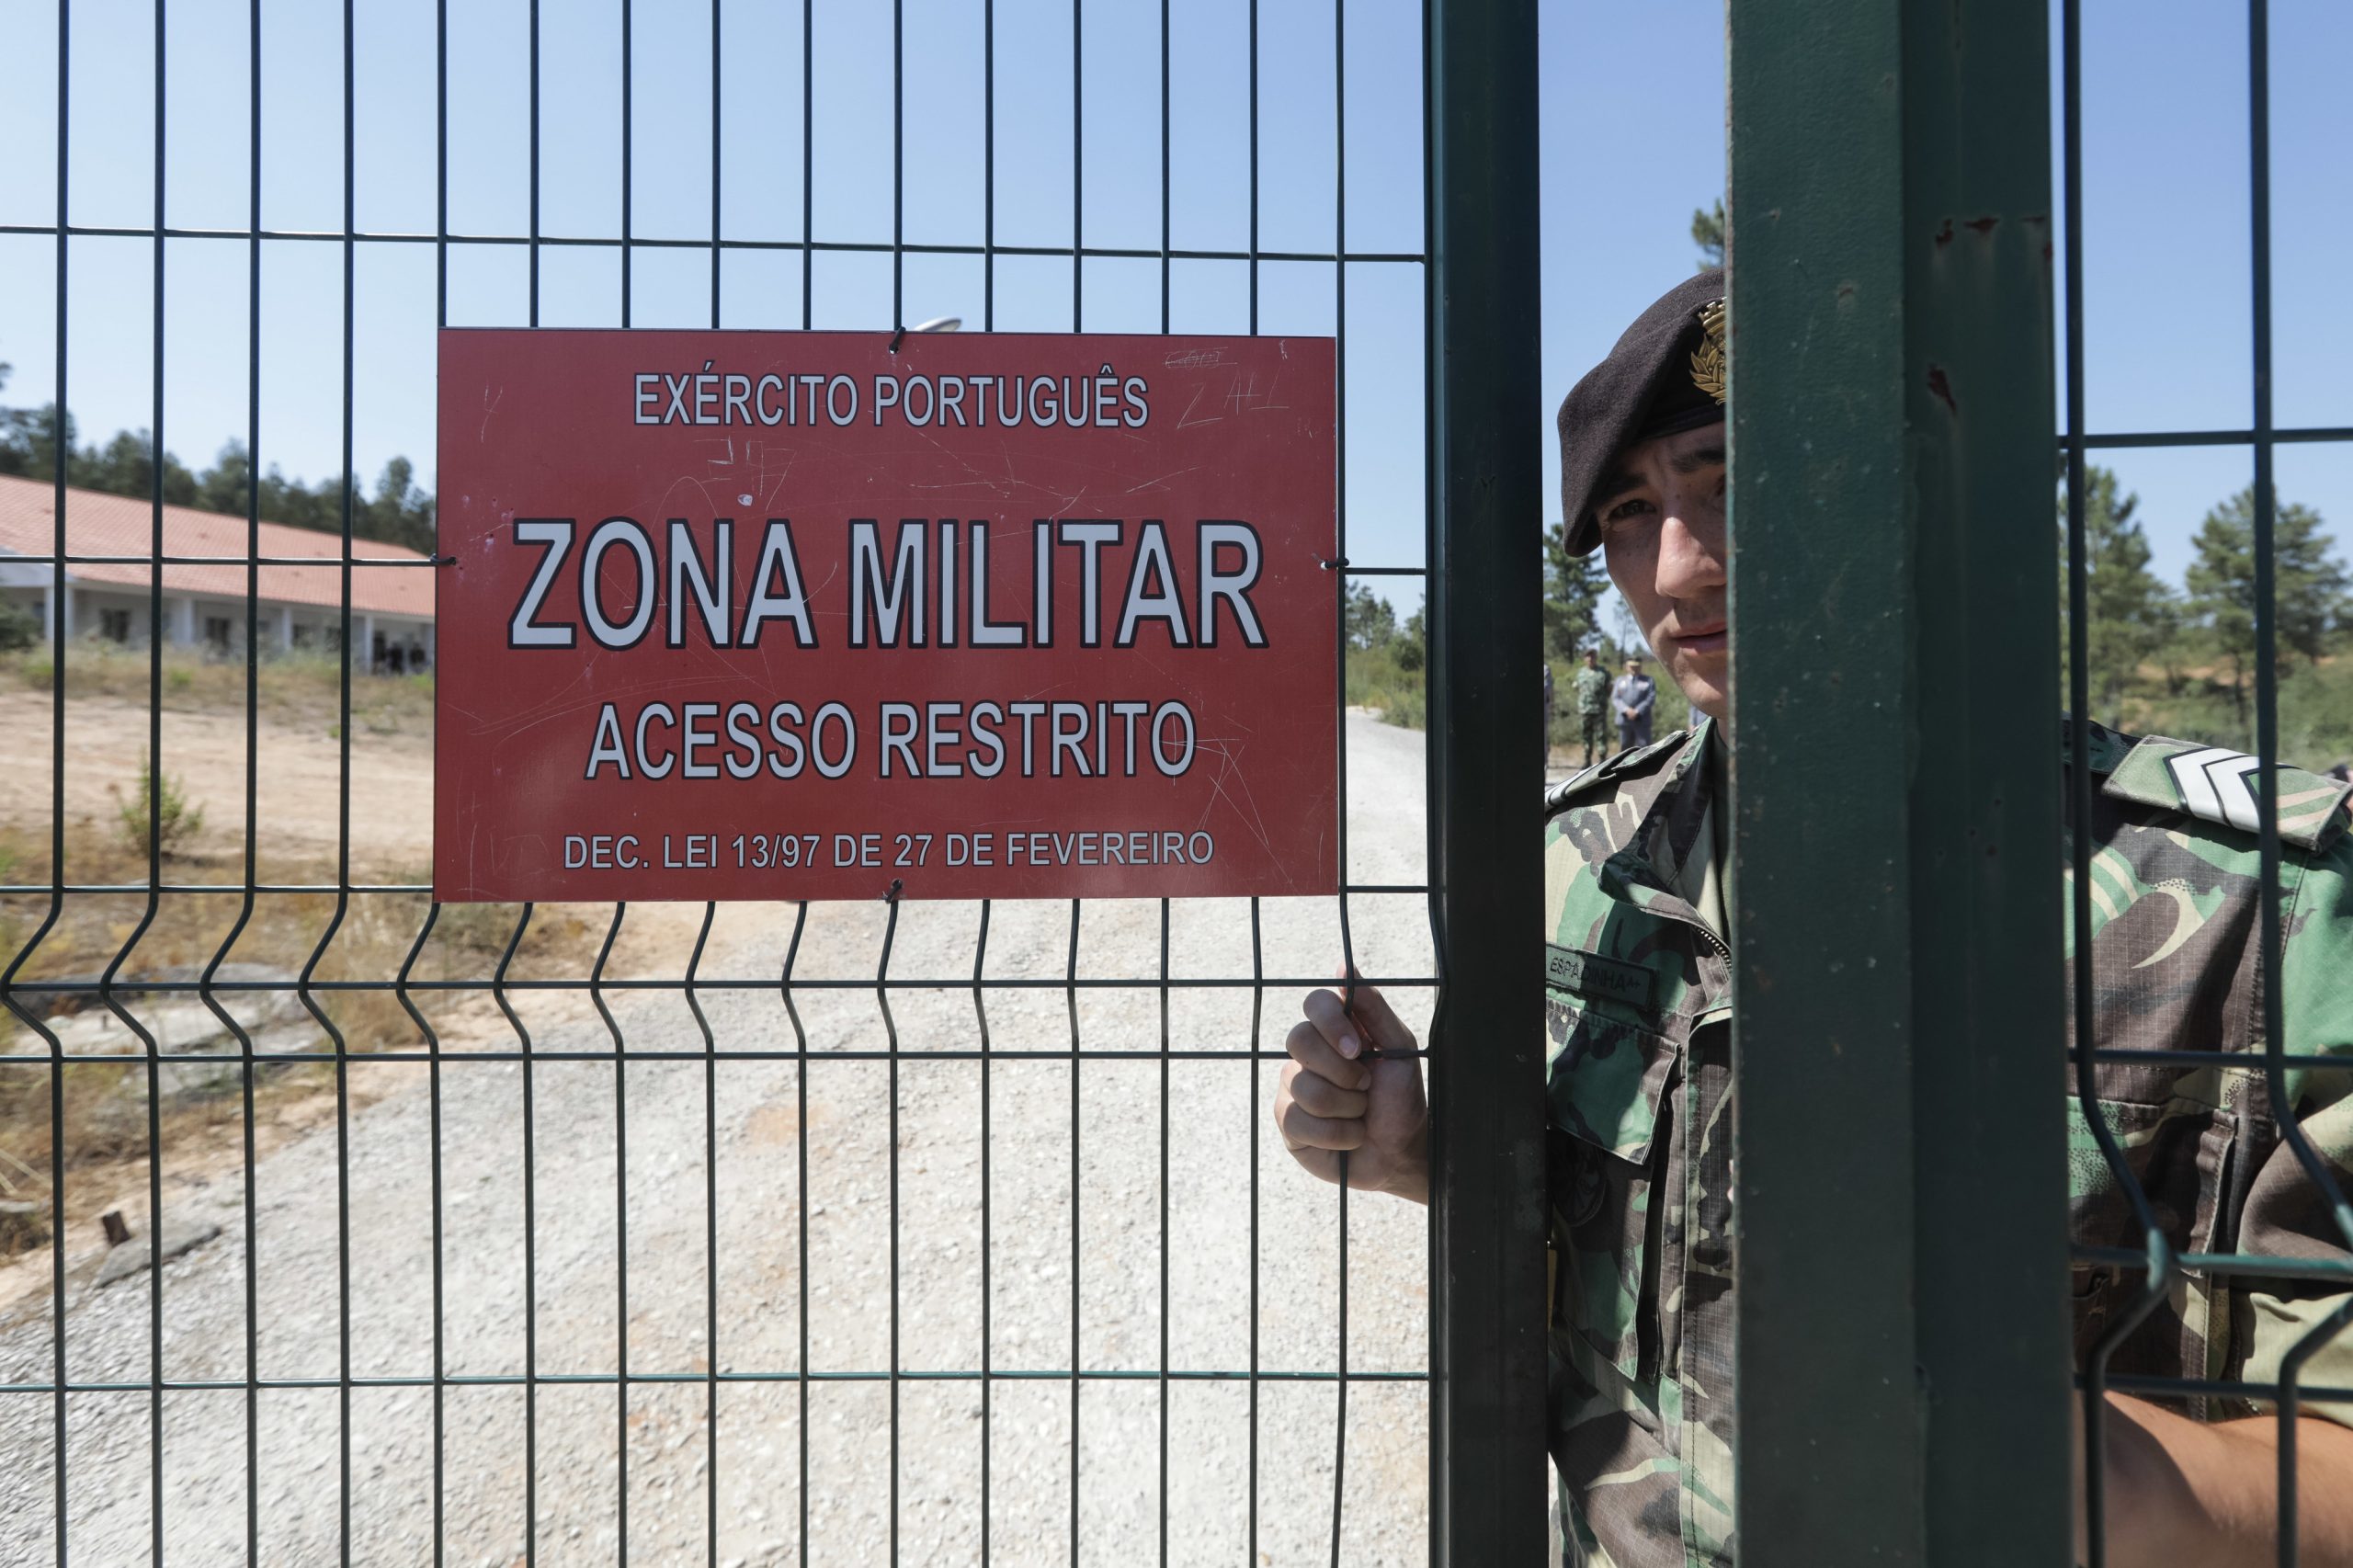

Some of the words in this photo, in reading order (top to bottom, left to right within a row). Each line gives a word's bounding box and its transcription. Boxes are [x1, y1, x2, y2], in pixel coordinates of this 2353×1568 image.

[633, 359, 860, 427] EXÉRCITO
[872, 363, 1151, 429] PORTUGUÊS
[506, 517, 819, 652] ZONA
[847, 518, 1269, 649] MILITAR
[583, 699, 858, 781] ACESSO
[878, 699, 1198, 780] RESTRITO
[563, 835, 650, 869] DEC.
[663, 834, 719, 869] LEI
[731, 833, 822, 869] 13/97
[833, 833, 883, 868] DE
[893, 833, 934, 868] 27
[945, 832, 995, 867] DE
[1006, 830, 1215, 867] FEVEREIRO
